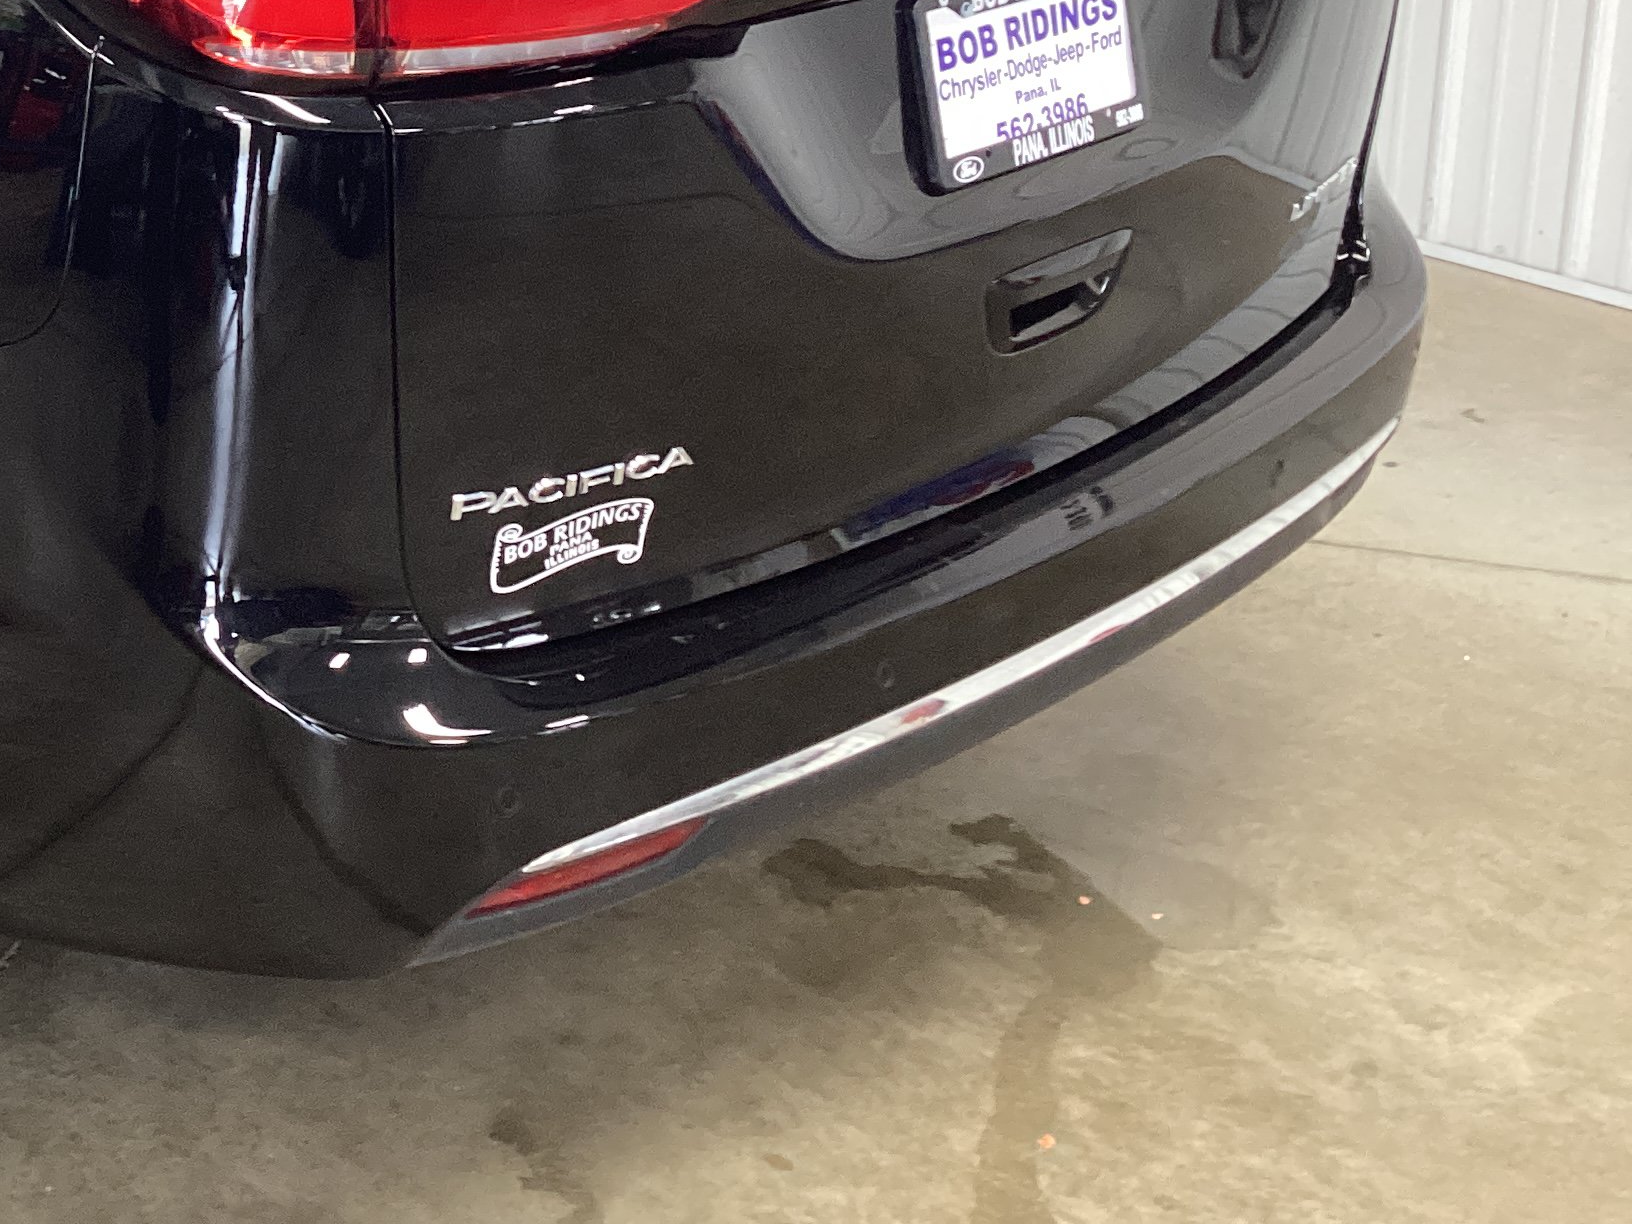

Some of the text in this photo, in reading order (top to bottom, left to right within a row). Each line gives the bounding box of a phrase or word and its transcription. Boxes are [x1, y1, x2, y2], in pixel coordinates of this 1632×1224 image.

[936, 24, 999, 73] BOB
[1050, 78, 1062, 93] IL
[1048, 114, 1095, 154] ILLINOIS
[450, 446, 694, 521] PACIFICA
[504, 502, 642, 564] BOB RIDINGS
[549, 531, 593, 557] PANA
[543, 538, 600, 570] ILLINOIS
